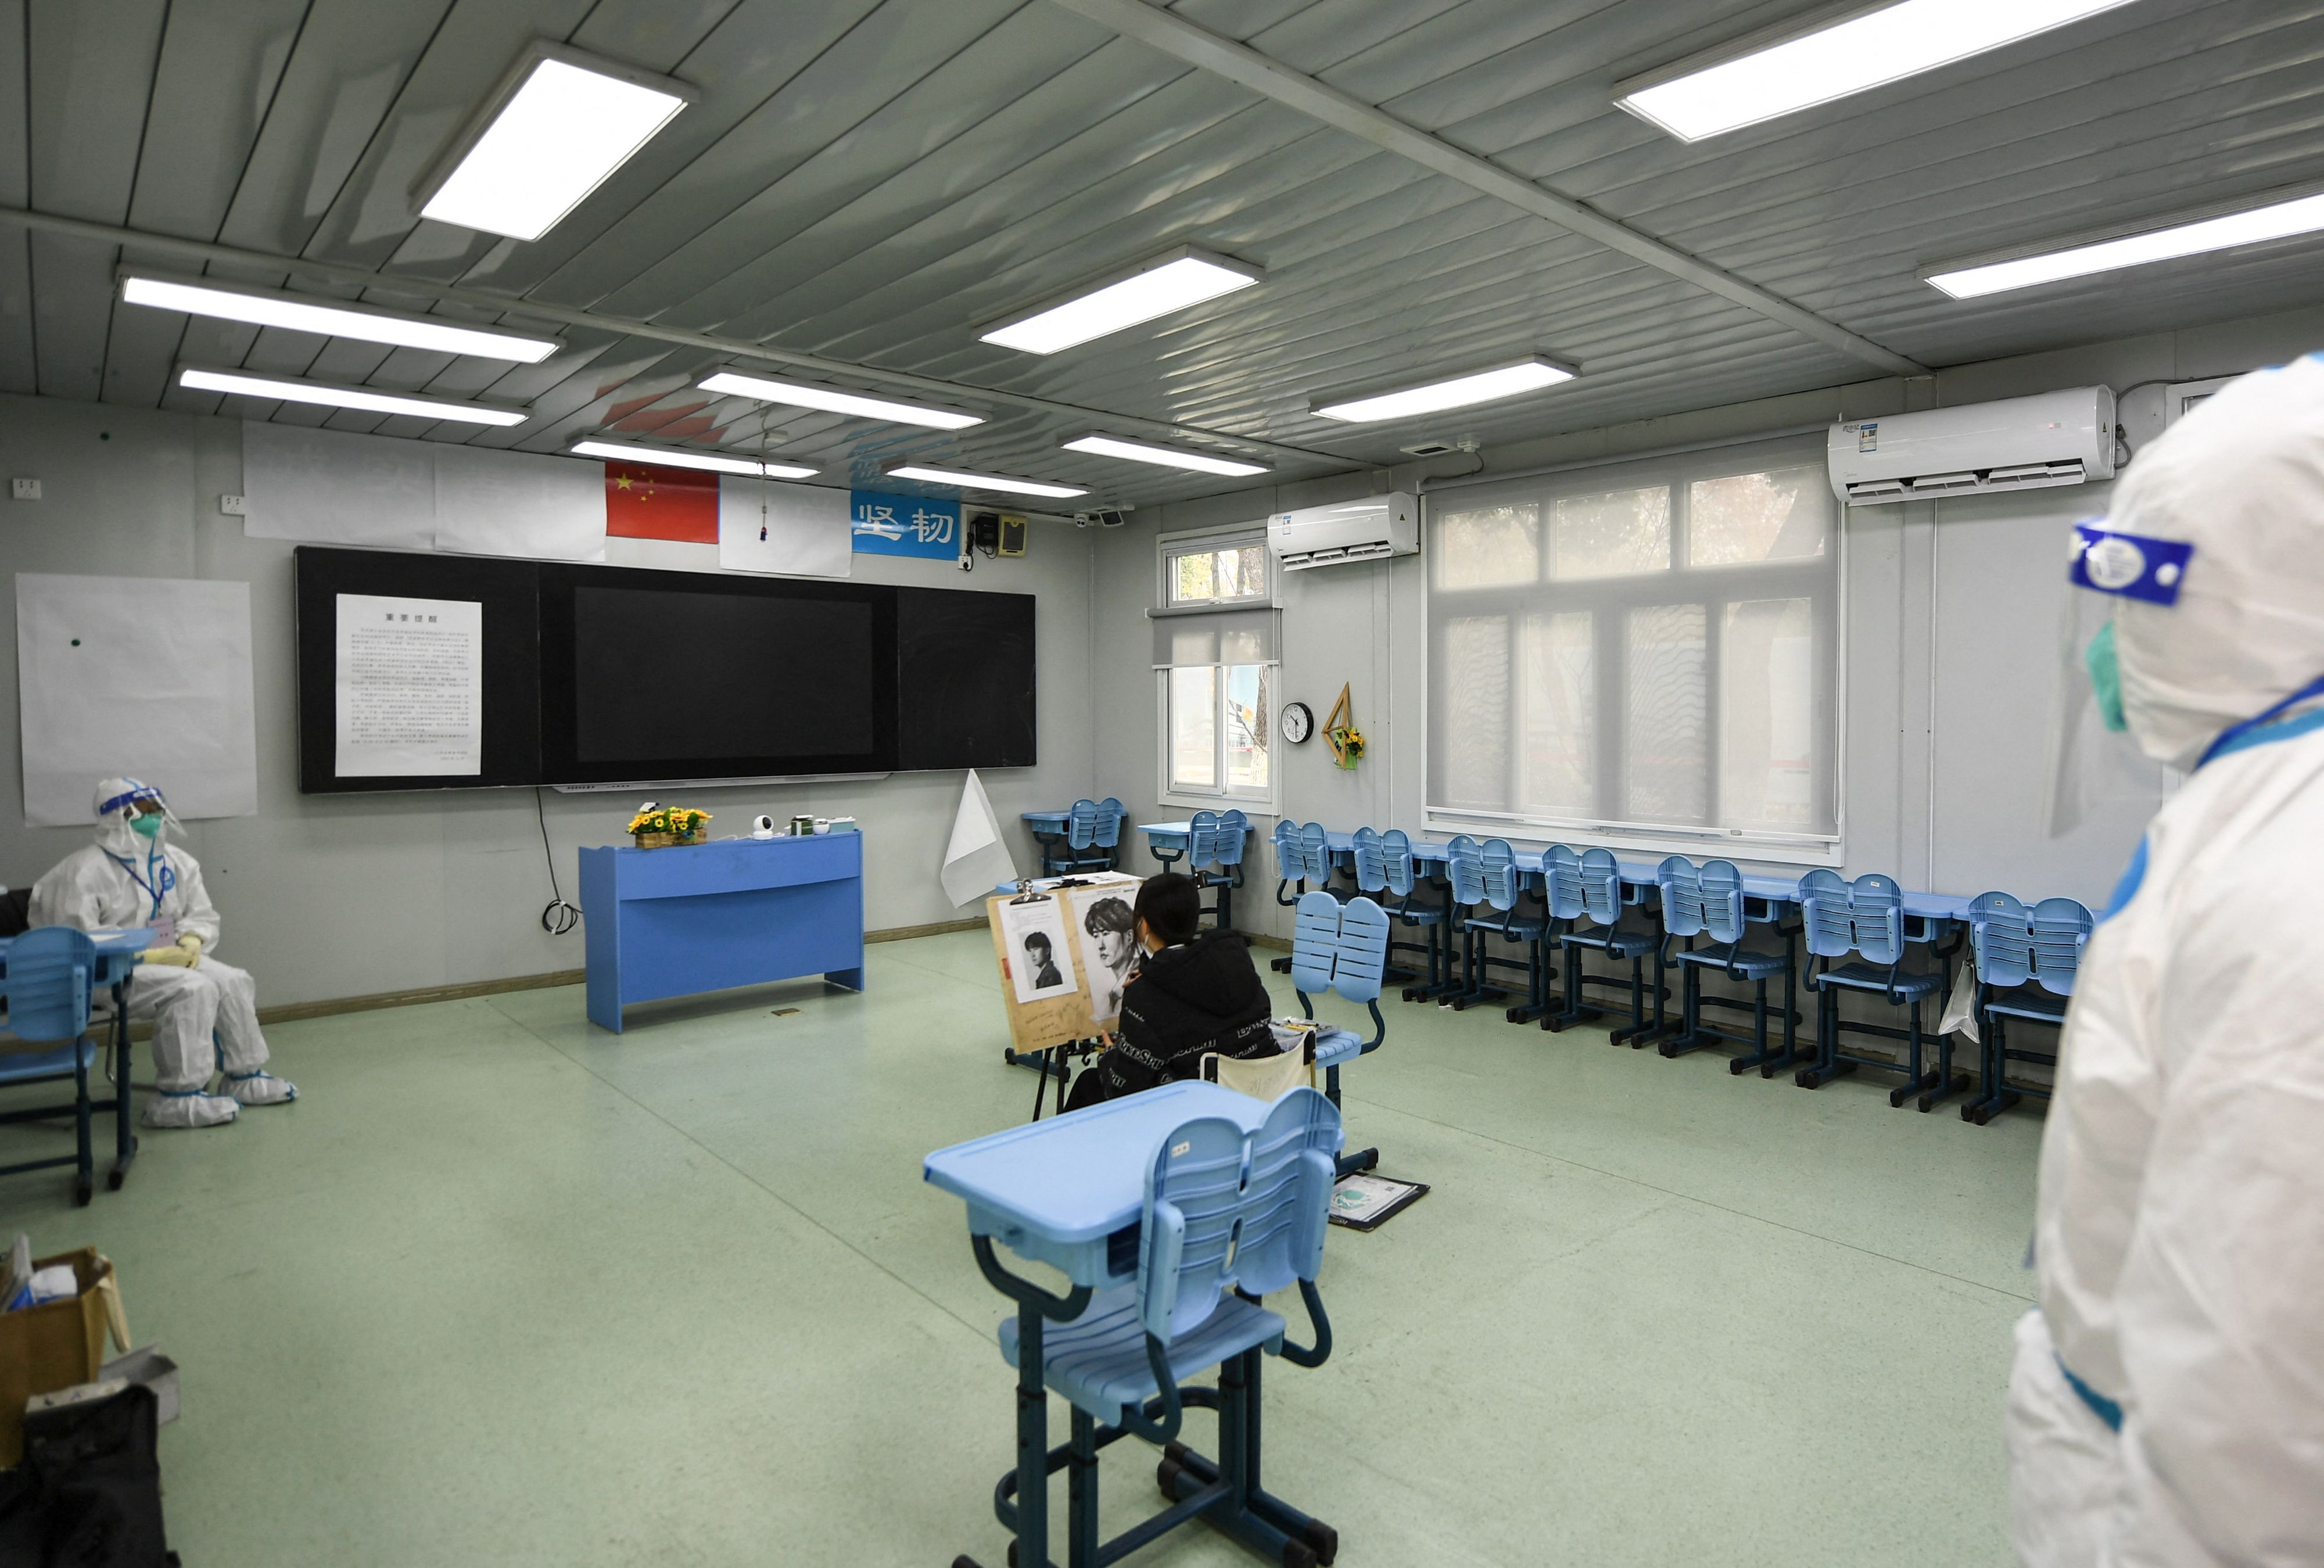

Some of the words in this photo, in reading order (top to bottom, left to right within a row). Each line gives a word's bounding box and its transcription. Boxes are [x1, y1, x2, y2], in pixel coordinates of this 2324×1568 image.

[853, 504, 953, 543] 坚韧
[385, 613, 437, 623] 重要提醒
